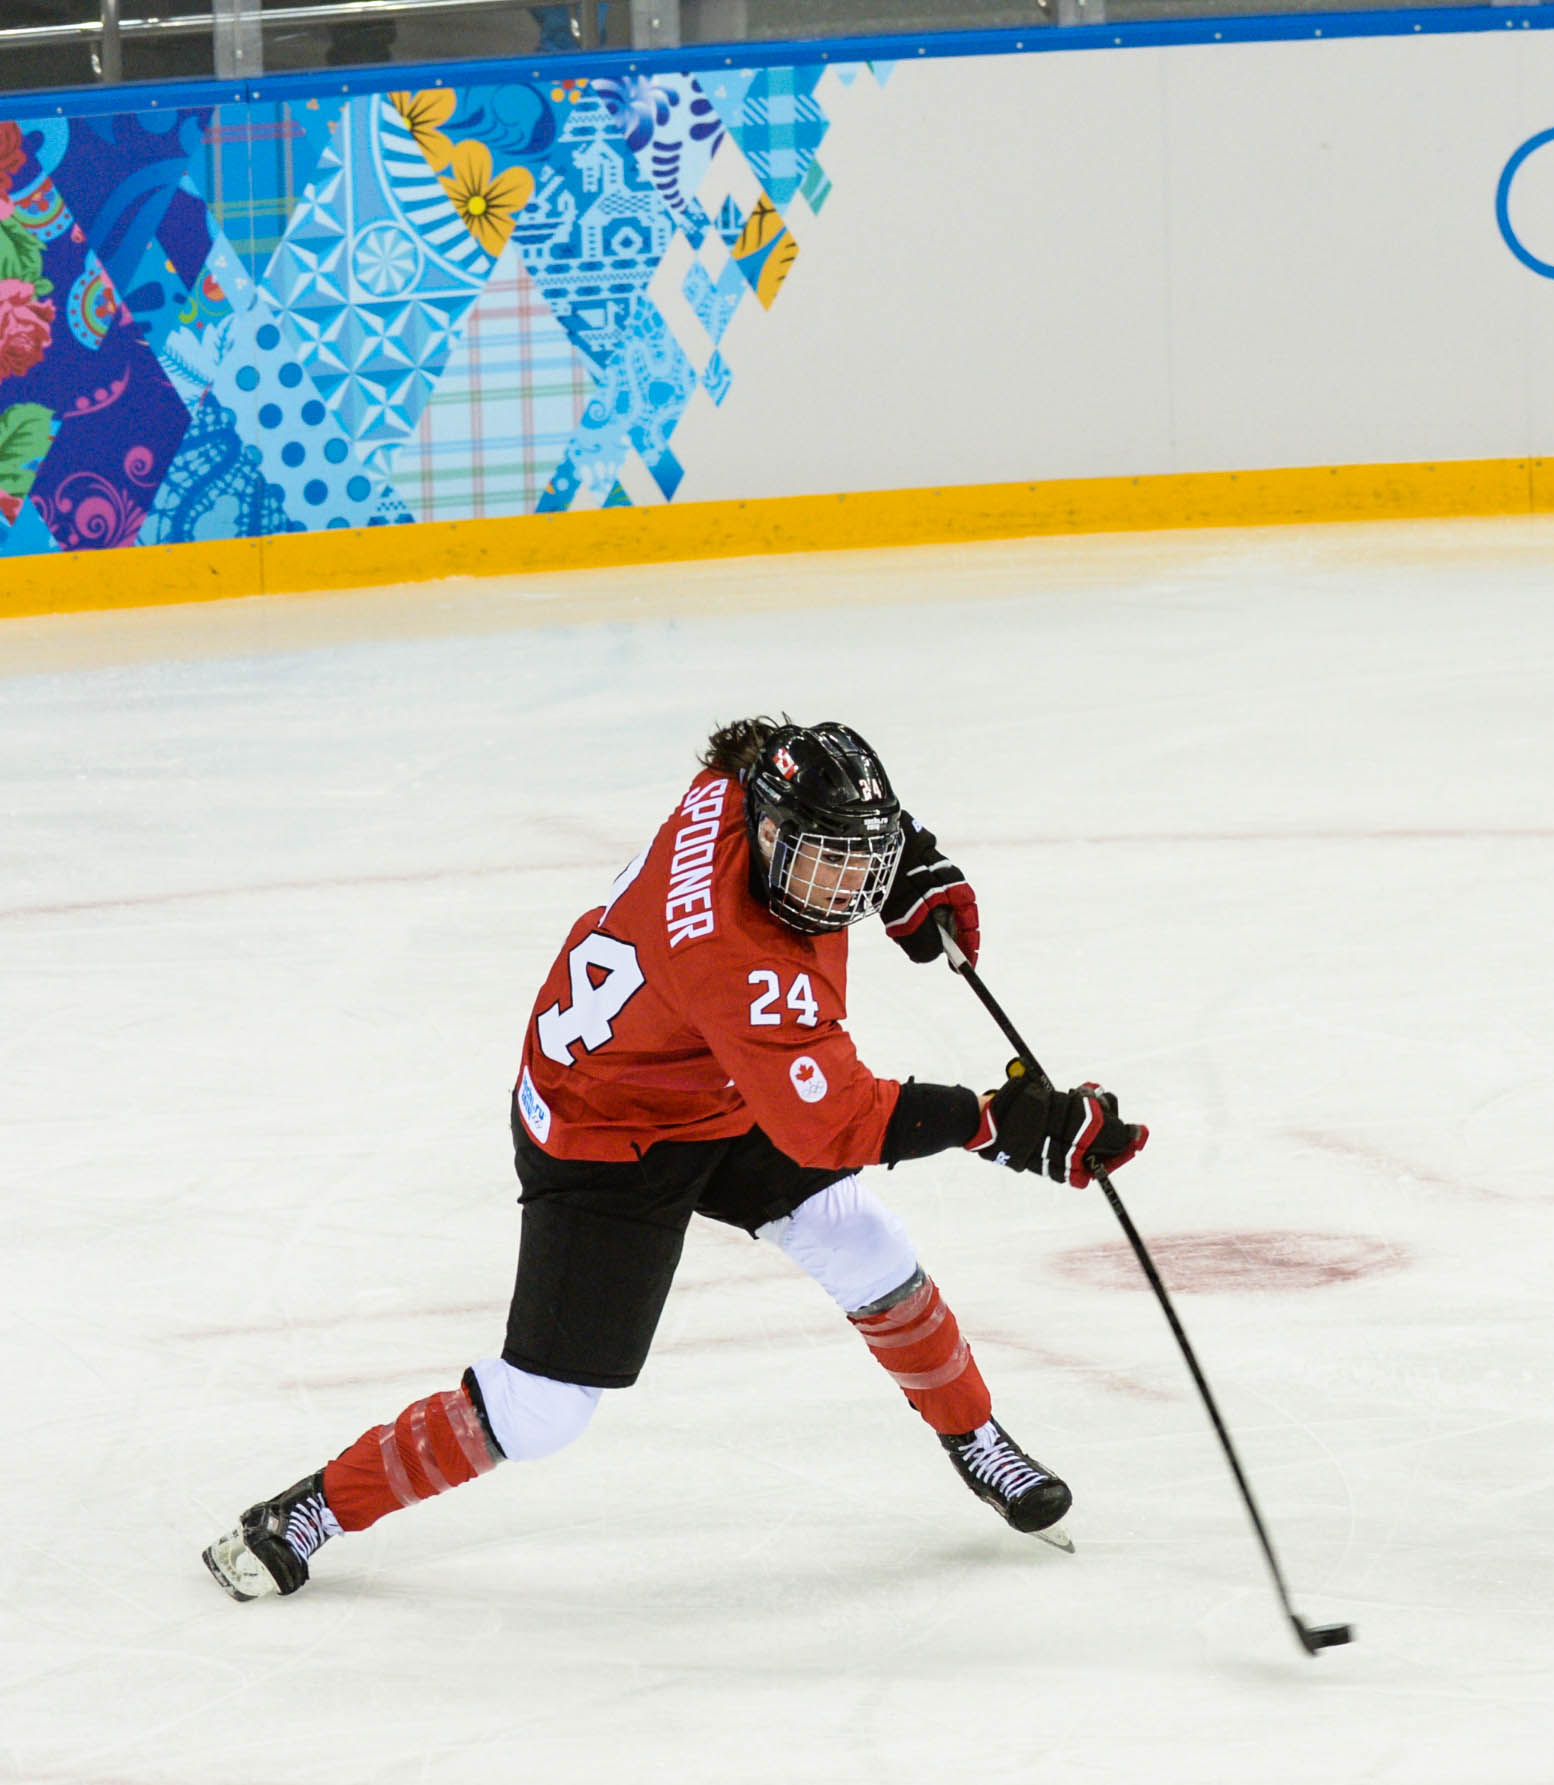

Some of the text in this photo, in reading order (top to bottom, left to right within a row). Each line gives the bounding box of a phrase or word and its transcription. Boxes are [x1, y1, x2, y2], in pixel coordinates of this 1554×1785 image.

[665, 778, 729, 948] SPOONER
[536, 848, 651, 1067] 4
[747, 968, 819, 1027] 24
